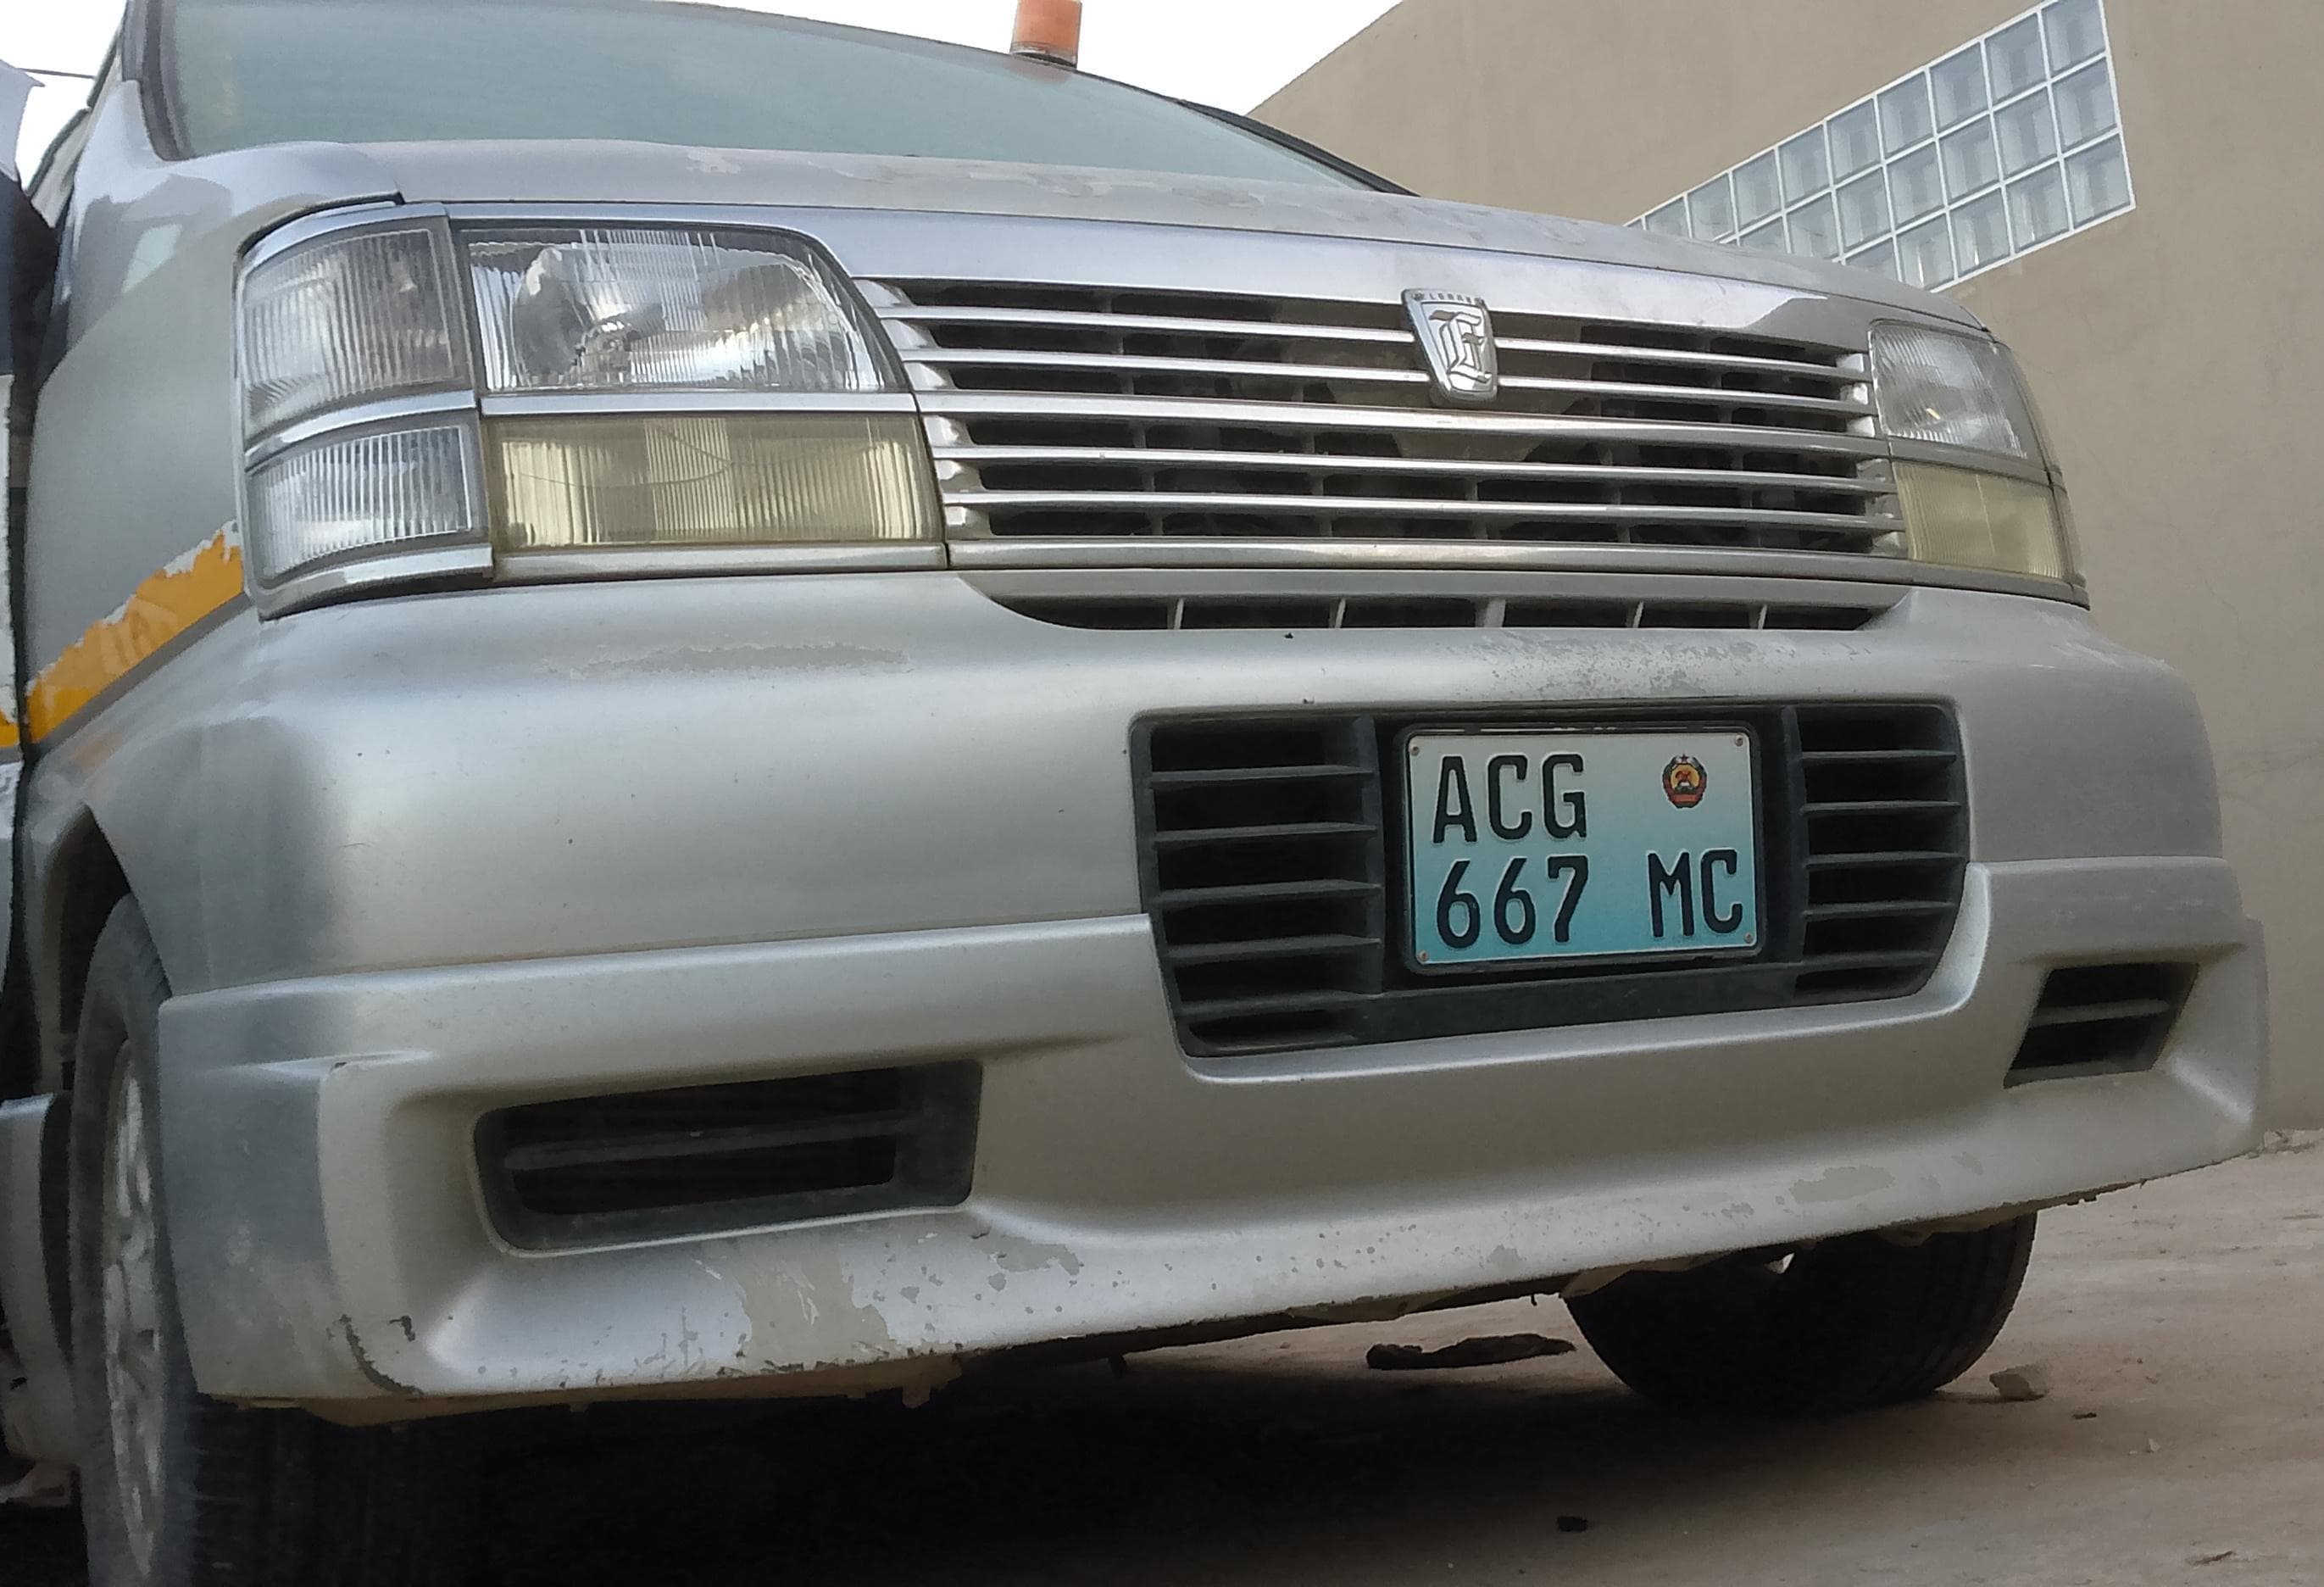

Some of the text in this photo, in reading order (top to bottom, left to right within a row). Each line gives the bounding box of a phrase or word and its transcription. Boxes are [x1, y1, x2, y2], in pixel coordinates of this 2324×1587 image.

[1432, 754, 1587, 844] ACG
[1436, 849, 1743, 949] 667 MC
